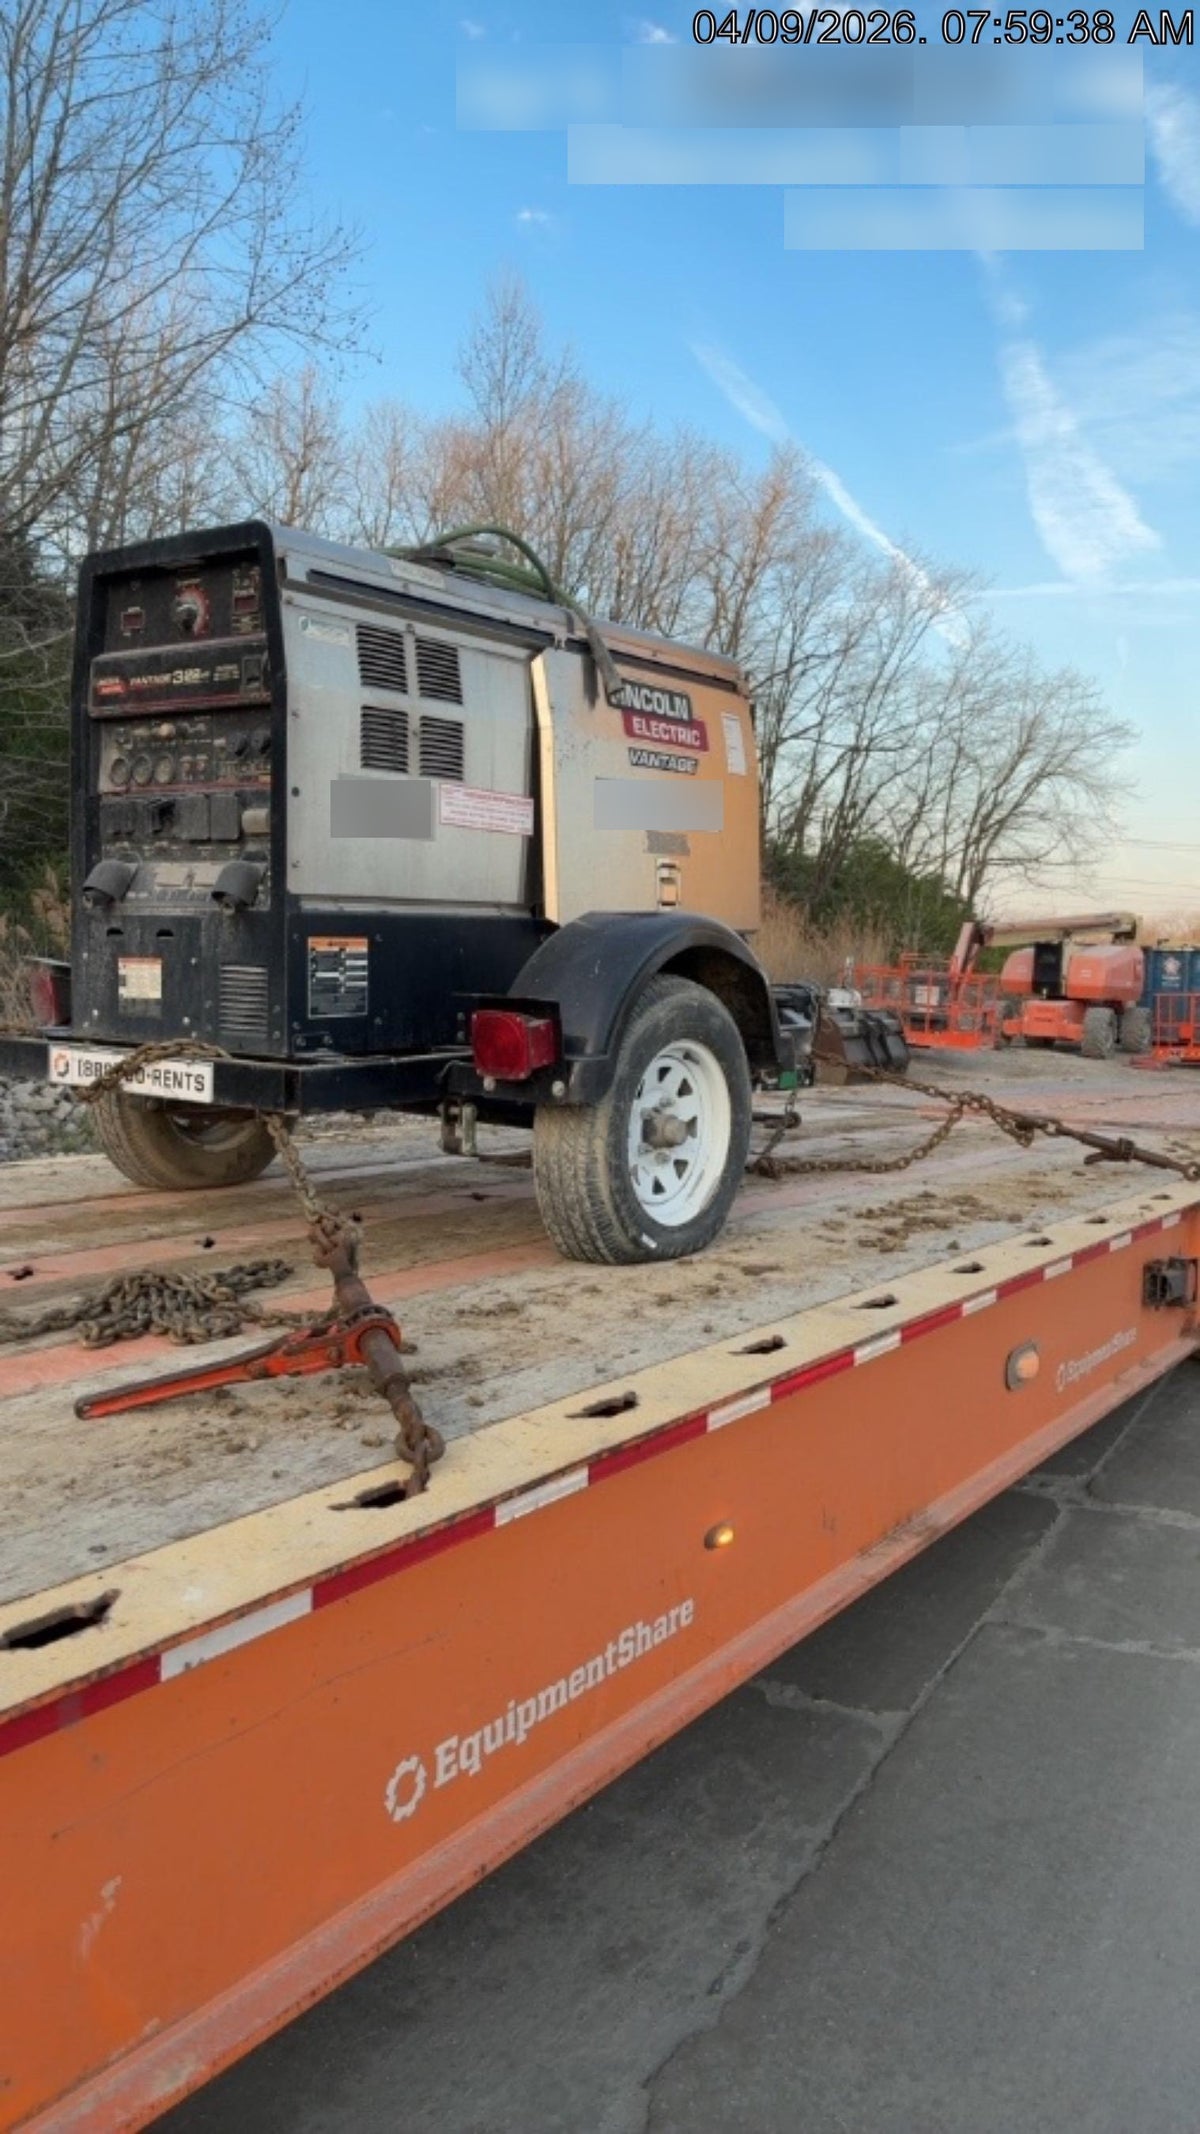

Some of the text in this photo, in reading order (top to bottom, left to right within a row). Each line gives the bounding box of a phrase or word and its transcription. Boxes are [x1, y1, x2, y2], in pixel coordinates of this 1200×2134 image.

[632, 716, 701, 746] ELECTRIC
[630, 749, 697, 773] VANTAGE
[433, 1598, 694, 1788] EquipmentShare
